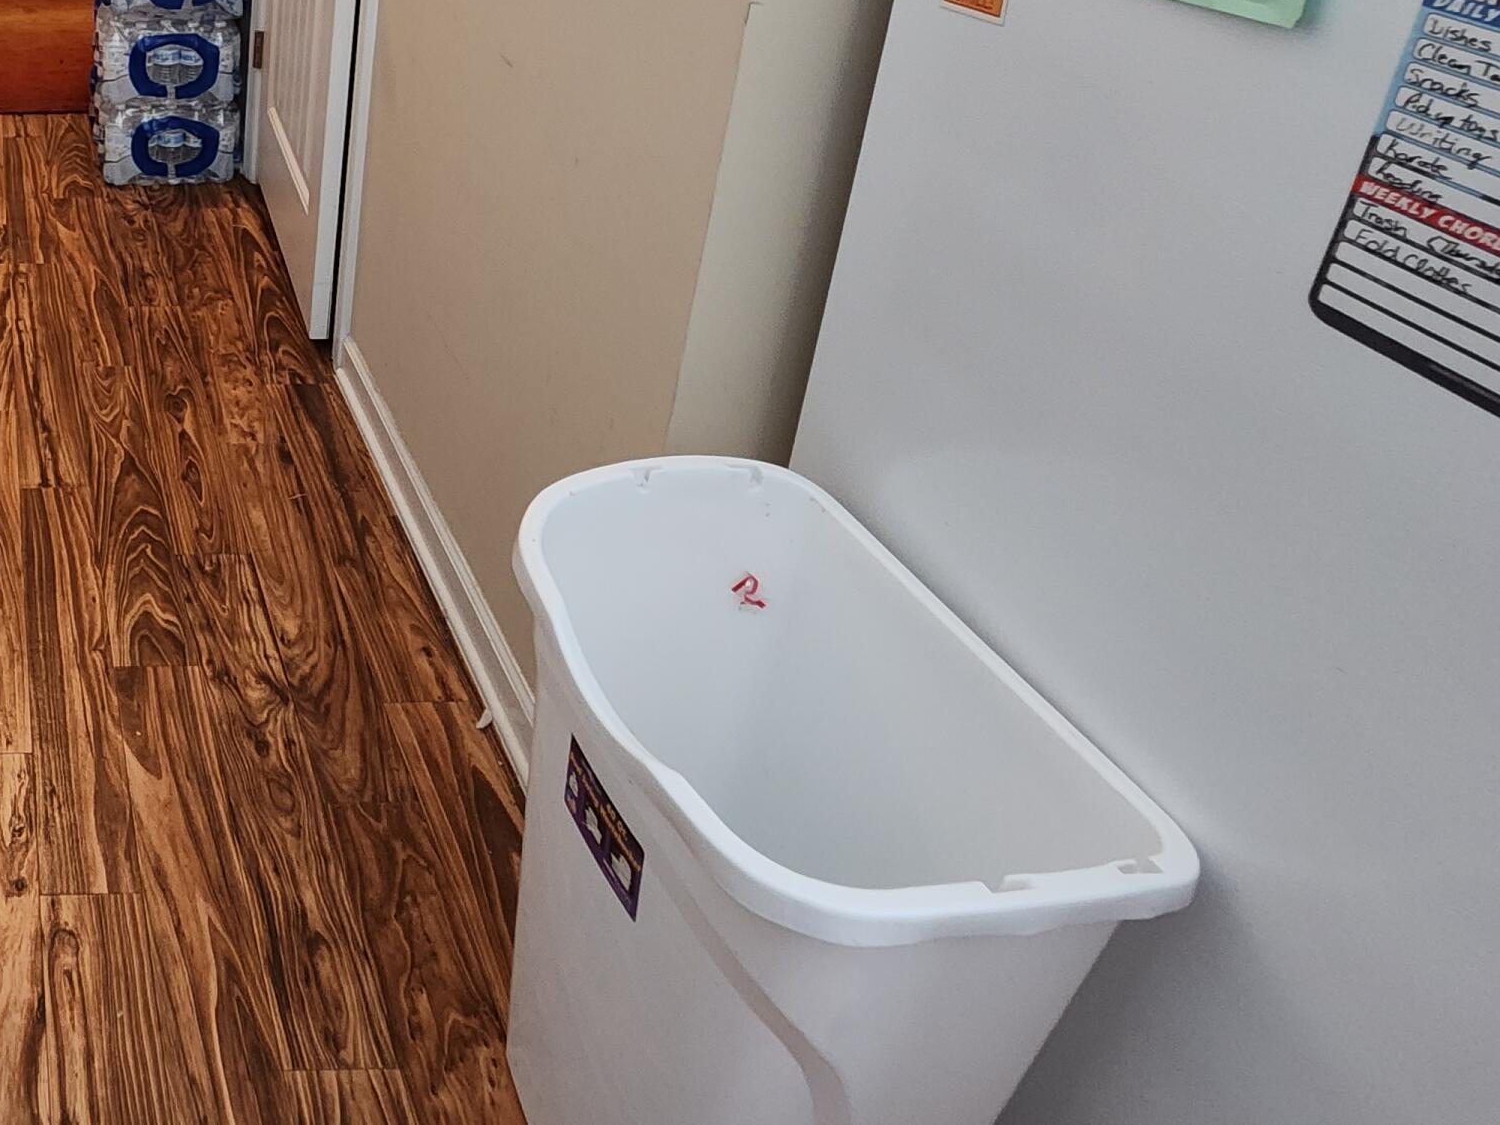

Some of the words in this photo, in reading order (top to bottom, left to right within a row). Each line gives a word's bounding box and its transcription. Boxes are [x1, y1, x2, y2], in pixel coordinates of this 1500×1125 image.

[1428, 17, 1493, 52] Dishes
[1359, 180, 1437, 220] WEEKLY
[1355, 227, 1401, 264] Fold
